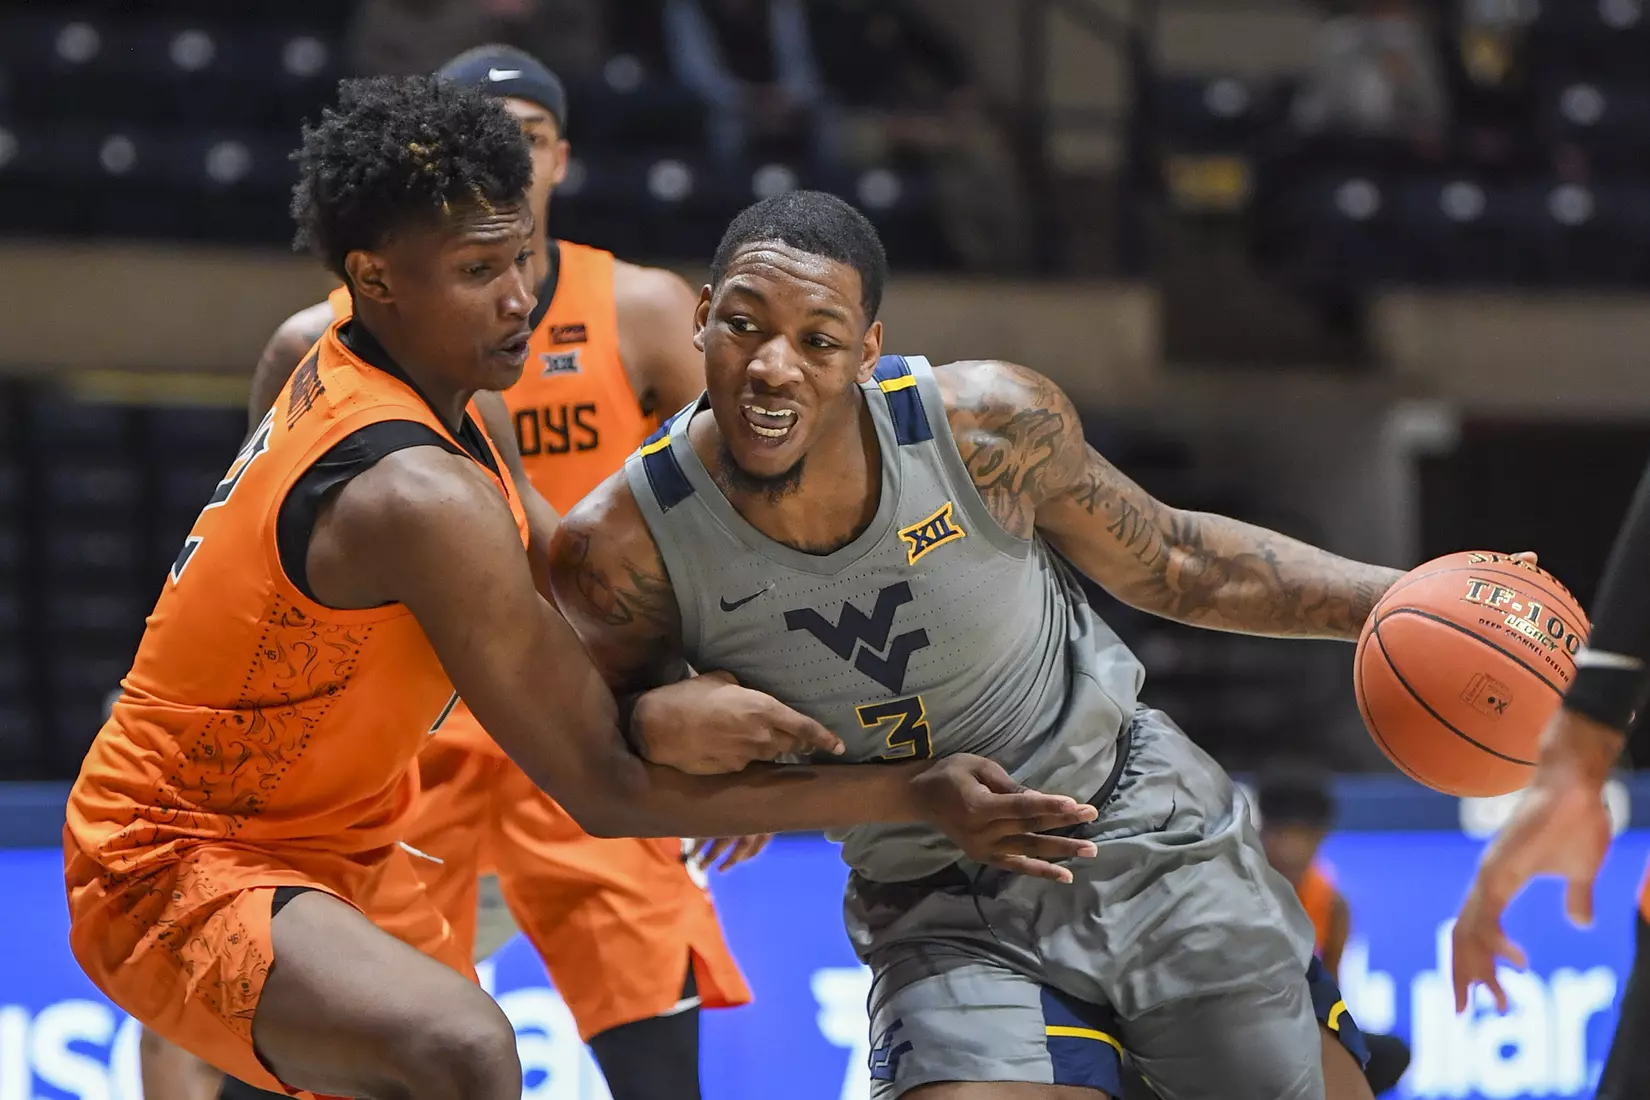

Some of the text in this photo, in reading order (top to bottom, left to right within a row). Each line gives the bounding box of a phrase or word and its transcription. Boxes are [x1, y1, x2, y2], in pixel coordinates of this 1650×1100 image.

[900, 505, 962, 561] XII
[1478, 617, 1570, 683] DEEP CHANNEL DESIGN
[855, 695, 934, 761] 3
